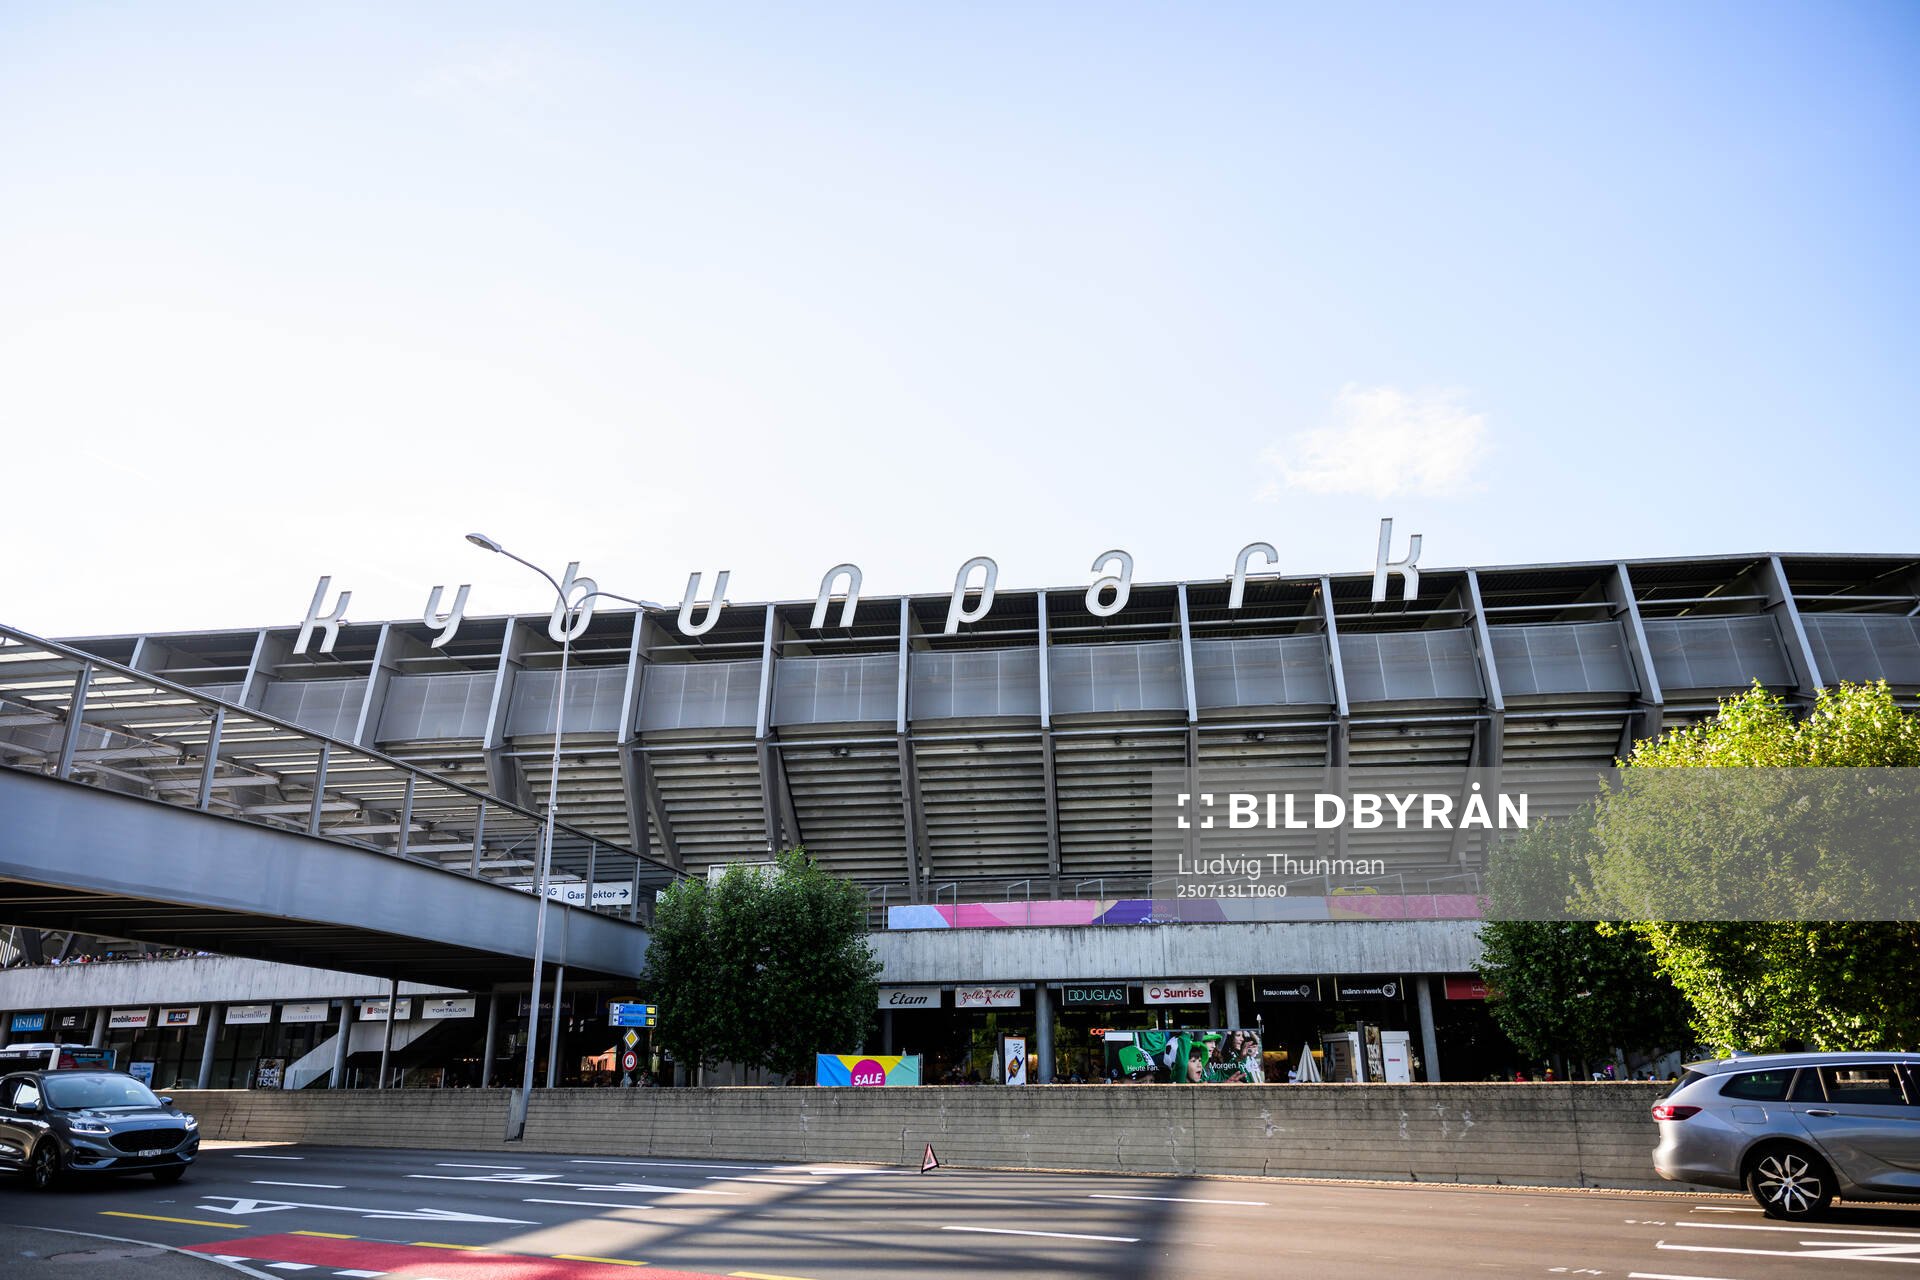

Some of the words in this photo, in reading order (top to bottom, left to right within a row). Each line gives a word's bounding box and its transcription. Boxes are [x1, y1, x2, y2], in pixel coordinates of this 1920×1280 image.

[567, 889, 617, 900] Gasektor
[889, 991, 928, 1005] Etam
[1068, 989, 1123, 1001] DOUGLAS
[1163, 987, 1204, 999] Sunrise
[62, 1016, 76, 1026] WE
[111, 1015, 147, 1023] mobilezone
[1208, 1062, 1237, 1070] Morgen
[260, 1068, 280, 1077] TSCH
[258, 1077, 279, 1086] TSCH
[853, 1072, 883, 1086] SALE
